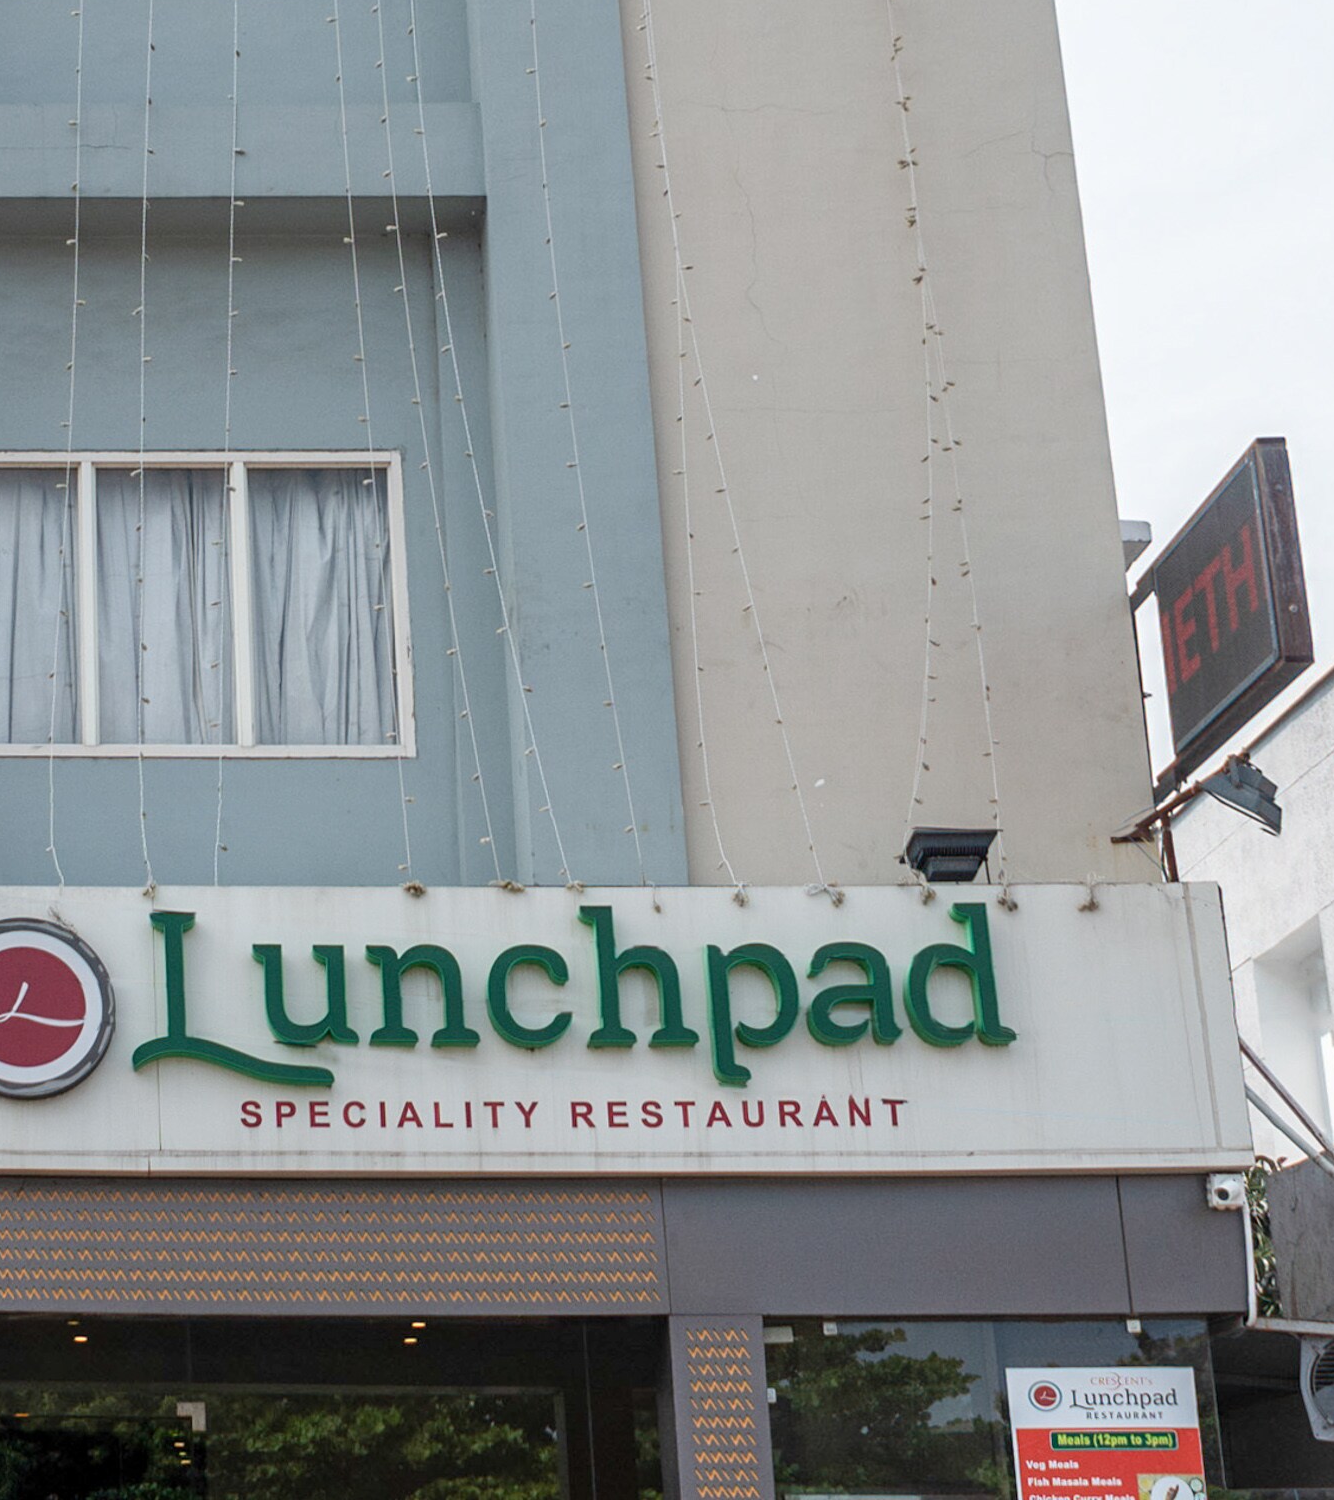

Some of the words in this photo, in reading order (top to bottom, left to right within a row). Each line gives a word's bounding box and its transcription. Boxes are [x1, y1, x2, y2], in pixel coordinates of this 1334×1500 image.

[131, 901, 1018, 1089] Lunchpad
[240, 1100, 540, 1130] SPECIALITY
[570, 1096, 908, 1130] RESTAURANT
[1069, 1387, 1179, 1410] Lunchpad
[1086, 1411, 1164, 1420] RESTAURANT
[1057, 1433, 1091, 1446] Meals
[1093, 1433, 1128, 1448] (12pm
[1130, 1434, 1142, 1445] to
[1145, 1433, 1174, 1448] 3pm)
[1026, 1459, 1046, 1471] Veg
[1048, 1459, 1079, 1469] Meals
[1027, 1476, 1049, 1487] Fish
[1052, 1476, 1089, 1487] Masala
[1091, 1476, 1122, 1486] Meals
